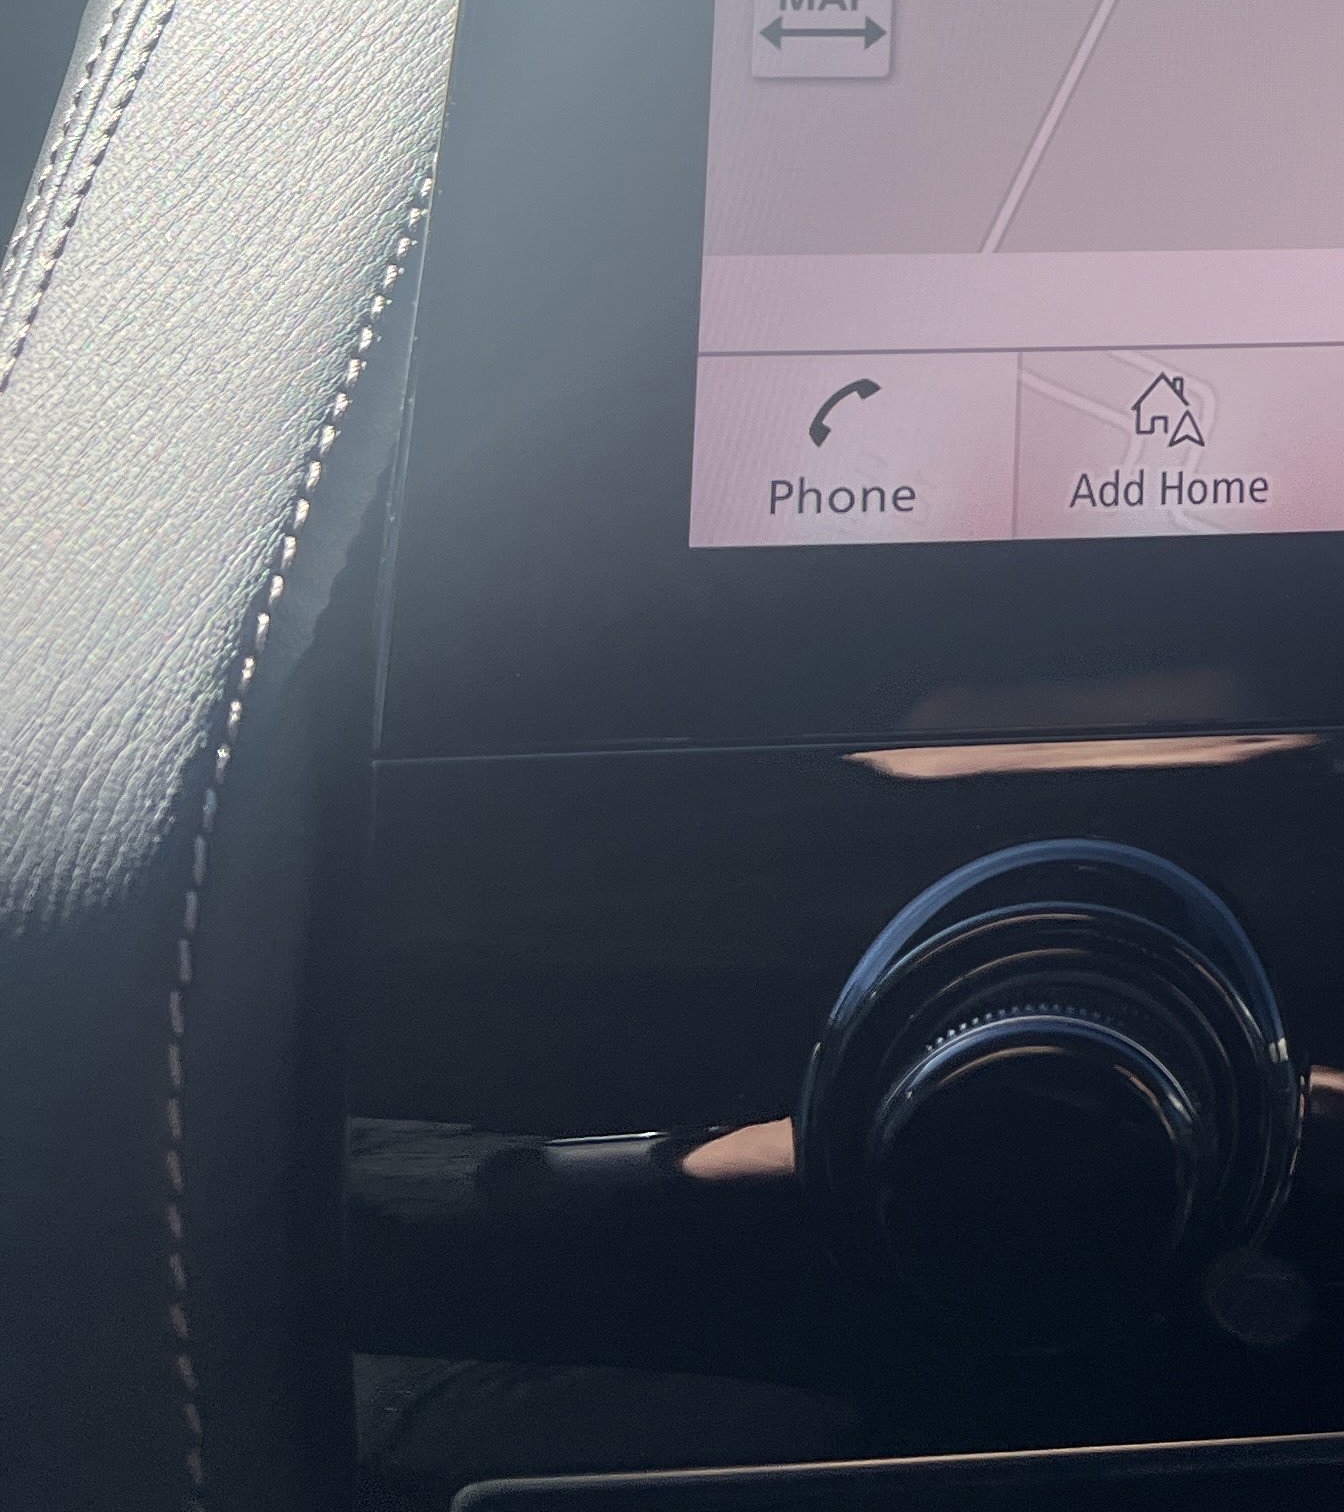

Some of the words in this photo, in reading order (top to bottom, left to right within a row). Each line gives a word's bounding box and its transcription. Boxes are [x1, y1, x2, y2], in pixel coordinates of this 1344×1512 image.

[769, 476, 917, 516] Phone
[1068, 469, 1145, 508] Add
[1160, 467, 1270, 506] Home
